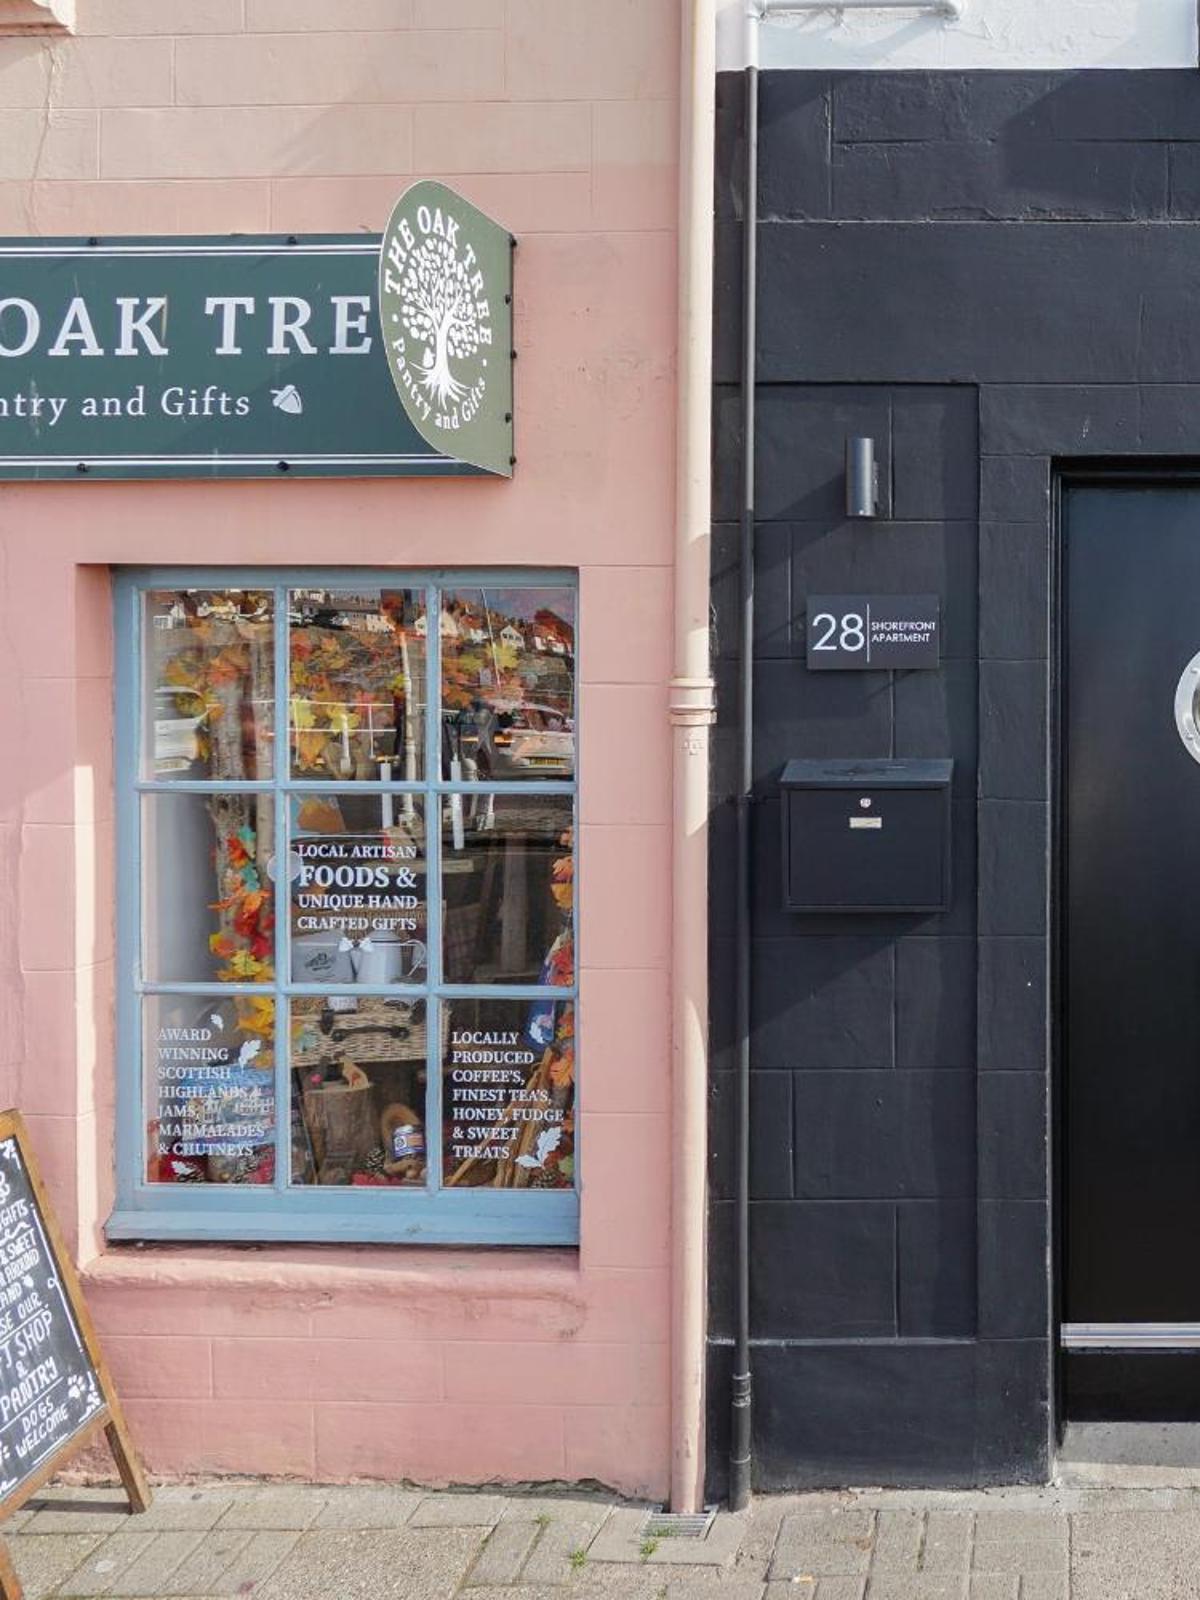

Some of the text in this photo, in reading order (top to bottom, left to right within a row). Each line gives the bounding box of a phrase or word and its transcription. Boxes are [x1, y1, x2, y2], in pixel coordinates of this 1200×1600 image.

[384, 206, 492, 345] THE OAK TREE
[0, 297, 169, 357] OAK
[392, 336, 486, 430] Pantry and Gifts
[81, 385, 146, 416] and
[161, 386, 250, 416] Gifts
[812, 613, 865, 652] 28
[871, 621, 936, 631] SHOREFRONT
[871, 633, 931, 643] APARTMENT
[297, 844, 417, 859] LOCAL ARTISAN
[299, 865, 417, 888] FOODS &
[298, 894, 418, 911] UNIQUE HAND
[297, 916, 417, 931] CRAFTED GIFTS
[157, 1028, 212, 1041] AWARD
[452, 1031, 520, 1045] LOCALLY
[158, 1047, 229, 1061] WINNING
[452, 1050, 535, 1064] PRODUCED
[157, 1066, 232, 1080] SCOTTISH
[452, 1089, 507, 1102] FINEST
[512, 1108, 565, 1121] FUDGE
[158, 1123, 265, 1137] MARMALADES
[452, 1126, 520, 1140] & SWEET
[158, 1142, 254, 1156] & CHUTNEYS
[453, 1145, 511, 1159] TREATS
[17, 1292, 43, 1320] OUR
[15, 1310, 53, 1357] SHOP
[0, 1355, 59, 1423] PANTRY
[21, 1396, 55, 1434] DOGS
[15, 1402, 70, 1459] WELCOME
